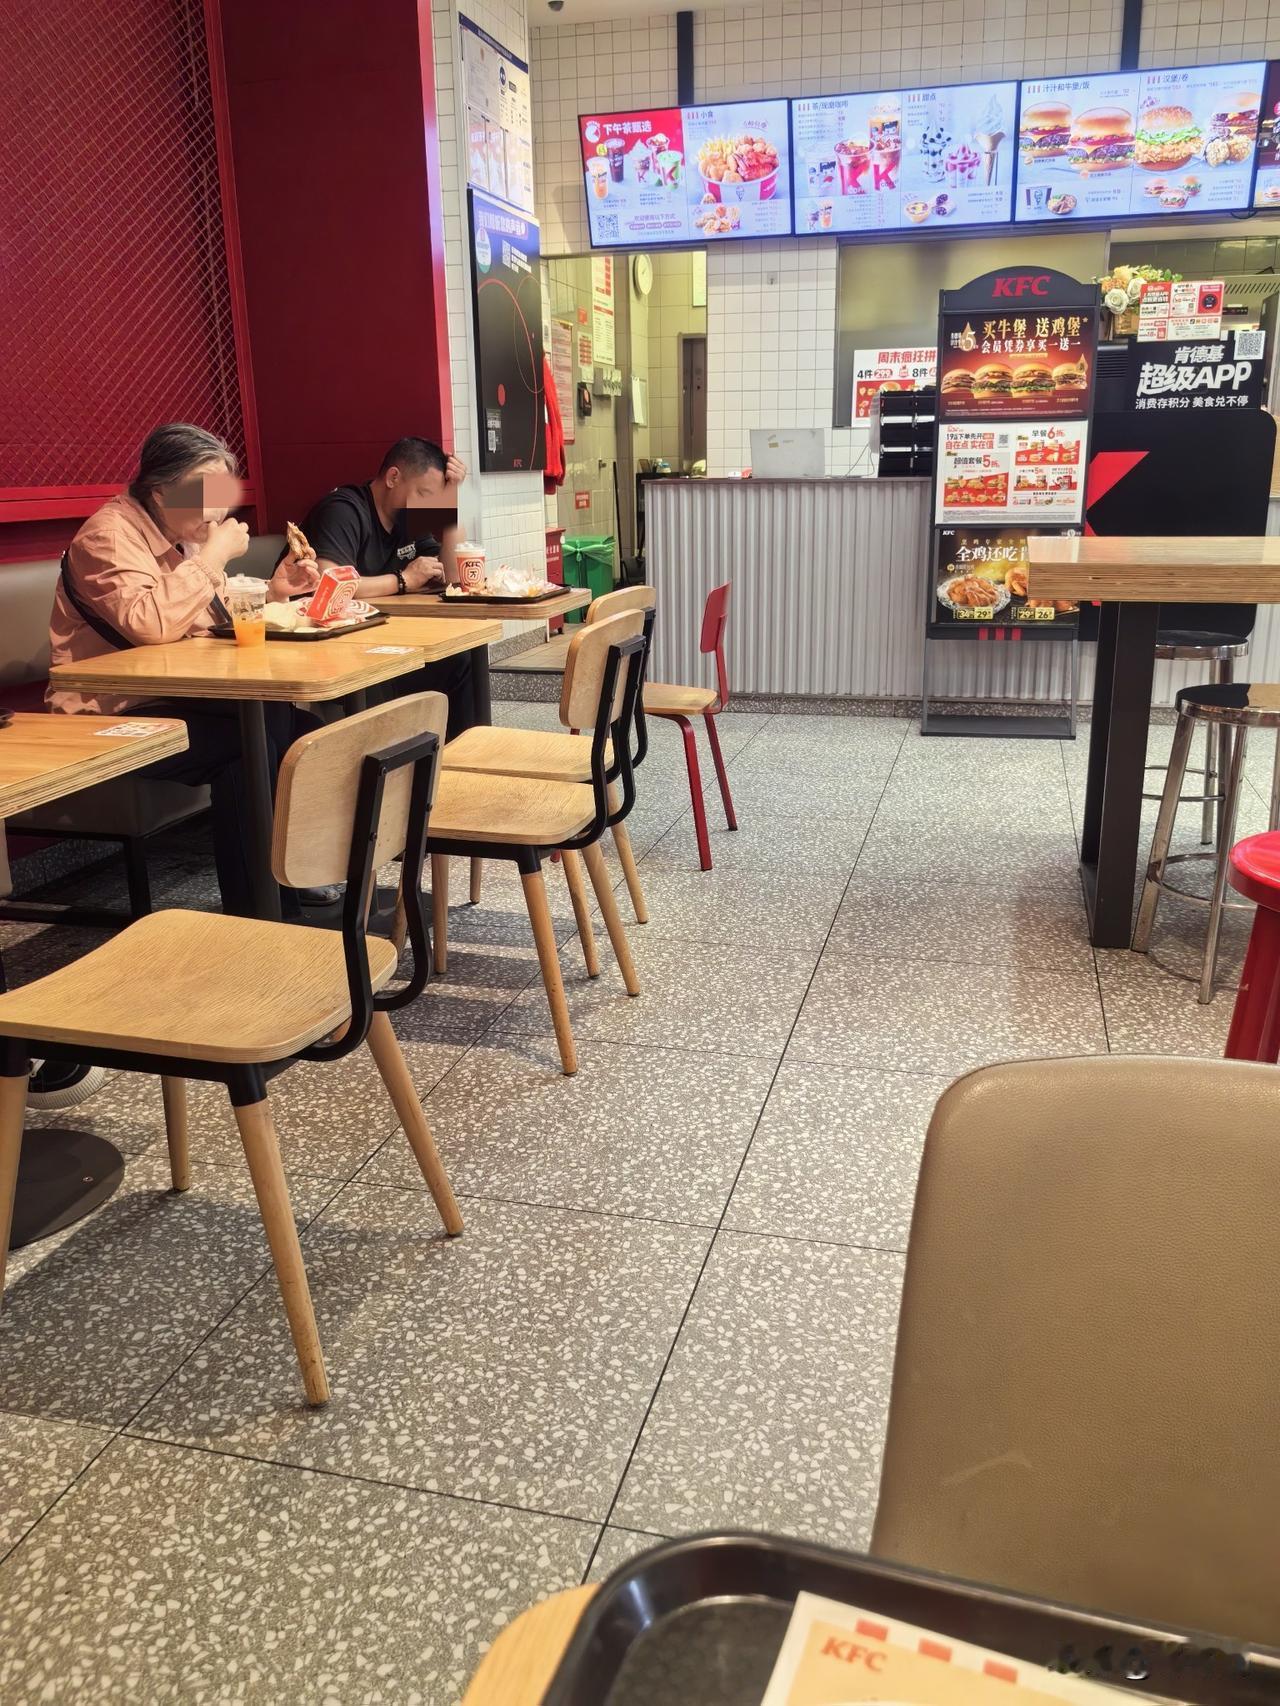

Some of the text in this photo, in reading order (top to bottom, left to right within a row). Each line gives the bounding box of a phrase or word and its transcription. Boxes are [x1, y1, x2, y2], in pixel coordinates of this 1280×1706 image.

[992, 274, 1052, 297] KFC
[982, 318, 1027, 340] 买牛堡
[982, 338, 1081, 354] 会员凭券享买一送一
[1174, 345, 1225, 364] 肯德基
[1136, 361, 1252, 398] 超级APP
[1136, 395, 1249, 410] 消费存积分 美食兑不停
[821, 1637, 888, 1673] KFC
